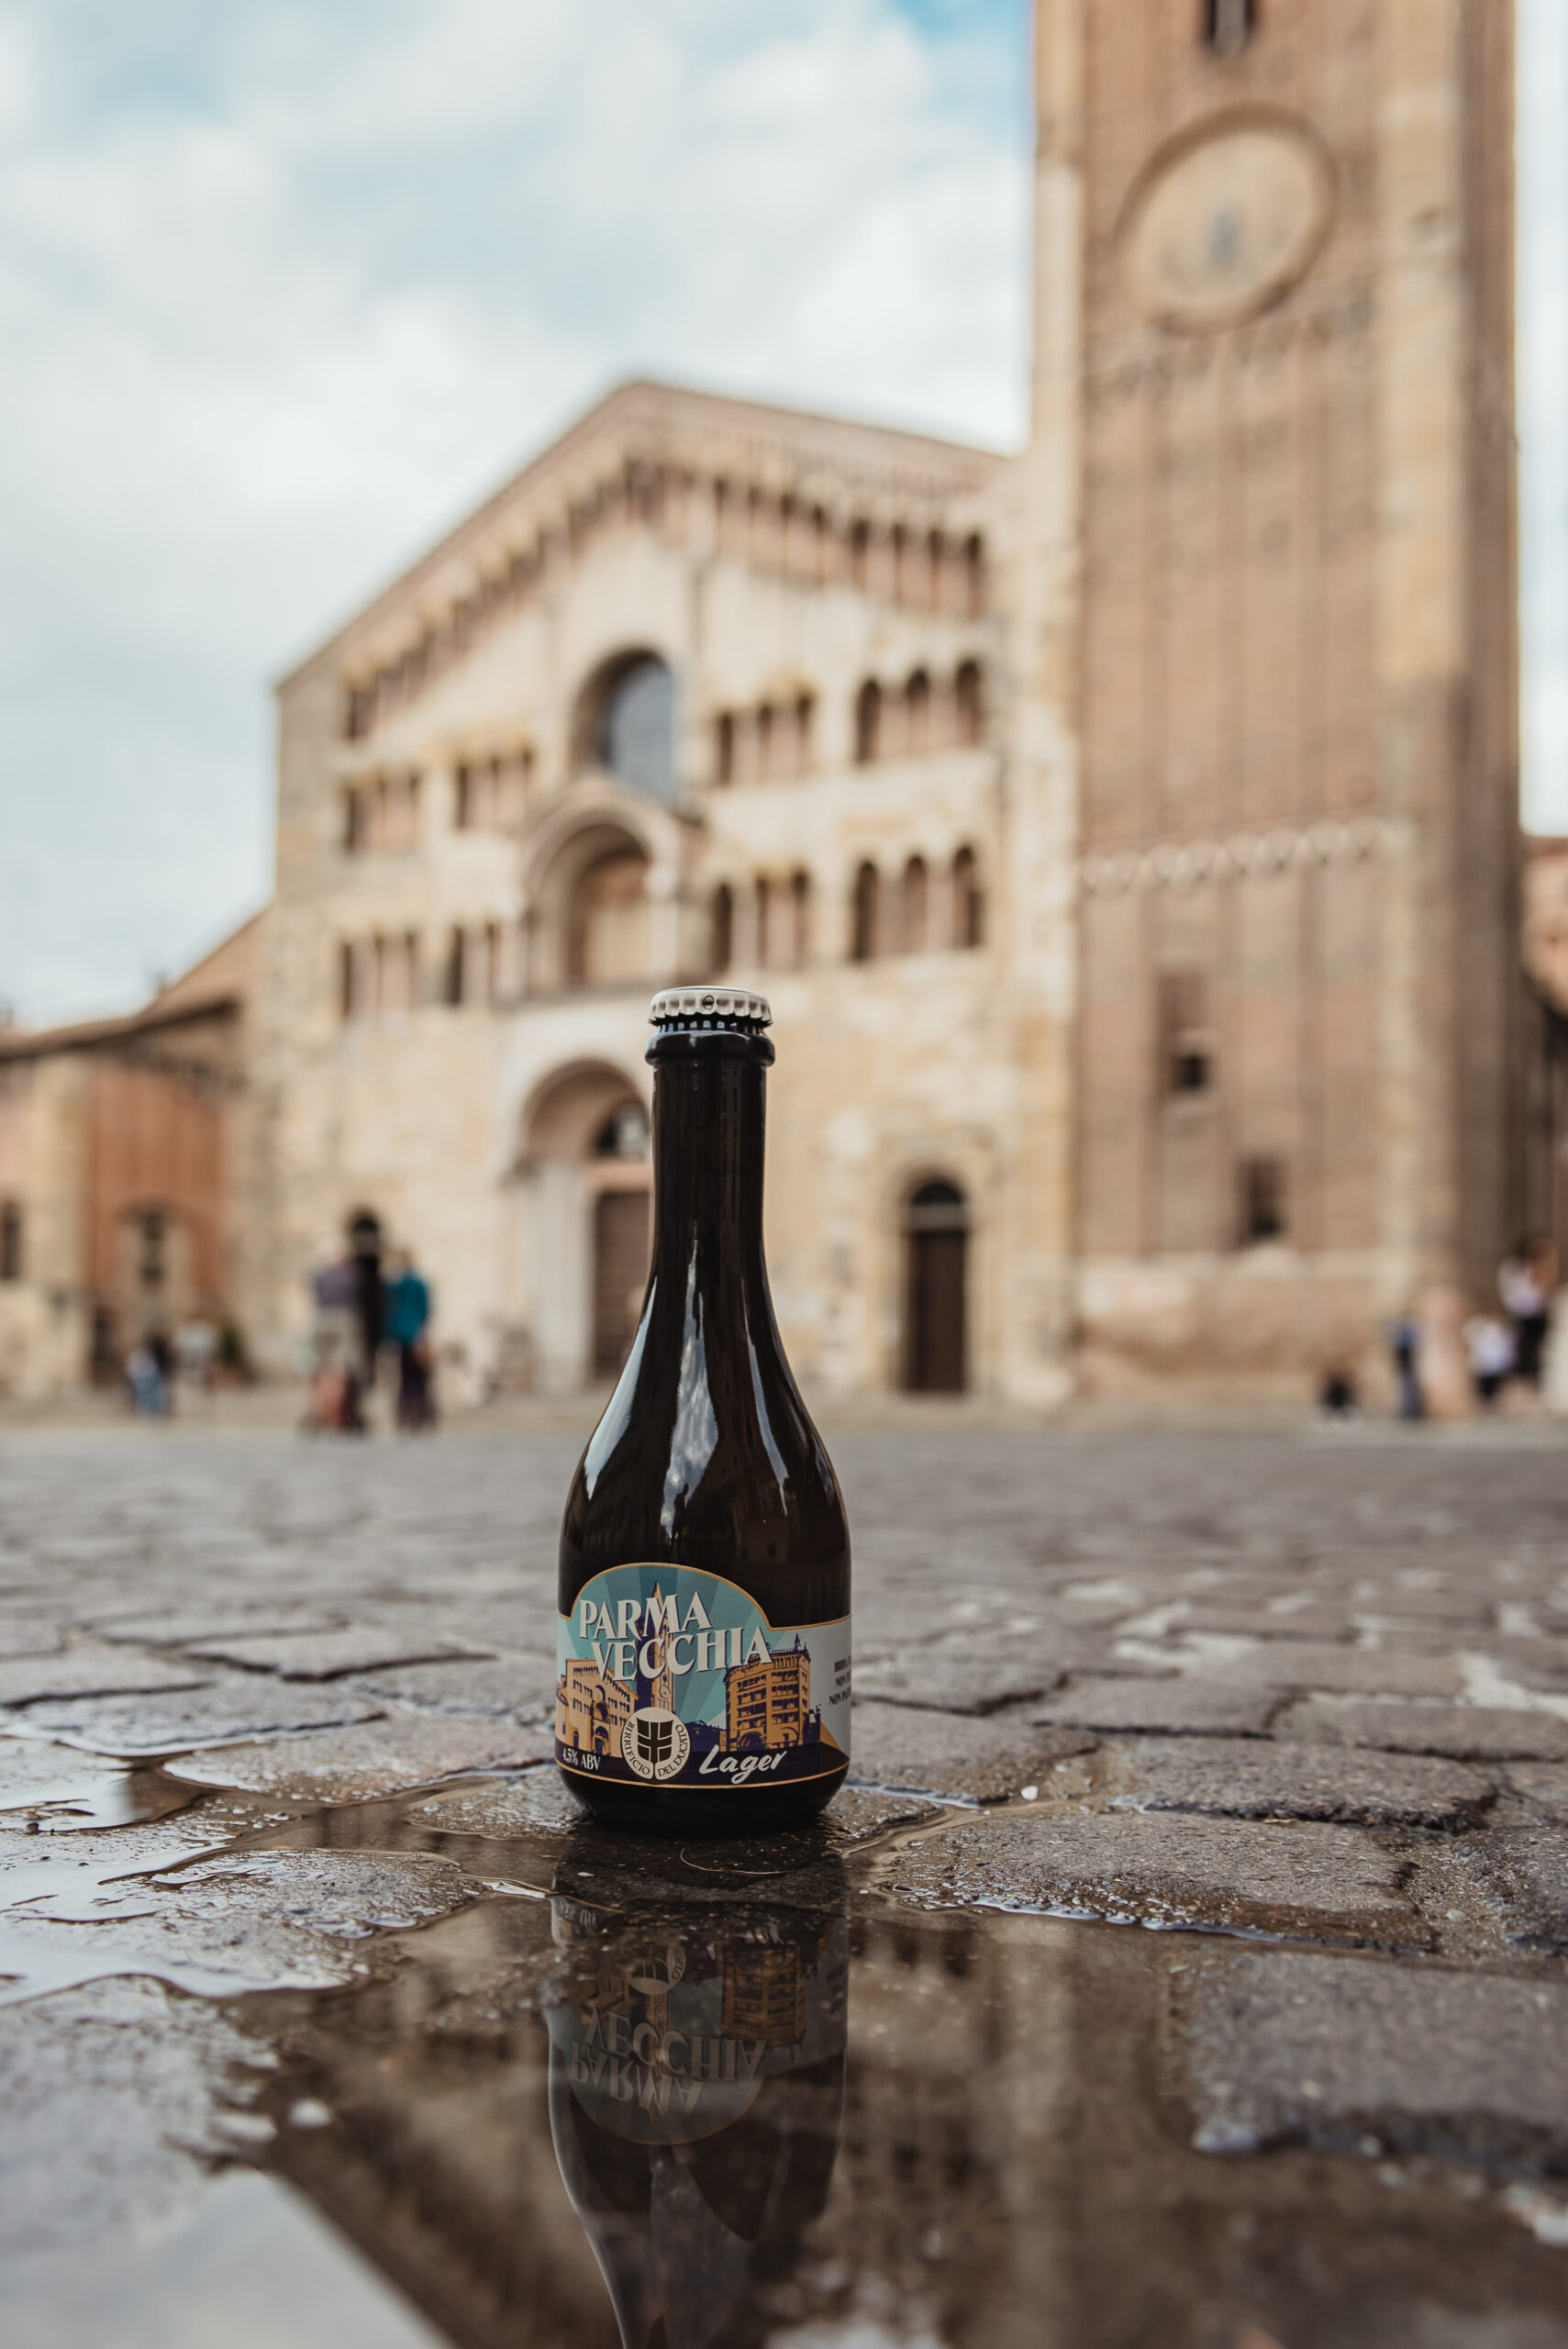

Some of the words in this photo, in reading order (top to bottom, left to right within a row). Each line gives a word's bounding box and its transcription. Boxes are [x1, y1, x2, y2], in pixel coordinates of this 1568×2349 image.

[580, 1590, 712, 1641] PARMA
[591, 1625, 772, 1681] VECCHIA
[580, 1753, 601, 1770] ABV
[624, 1720, 651, 1775] BIRRIFICIO
[657, 1765, 676, 1776] DEL
[673, 1724, 687, 1765] DUCATO
[699, 1744, 787, 1784] Lager
